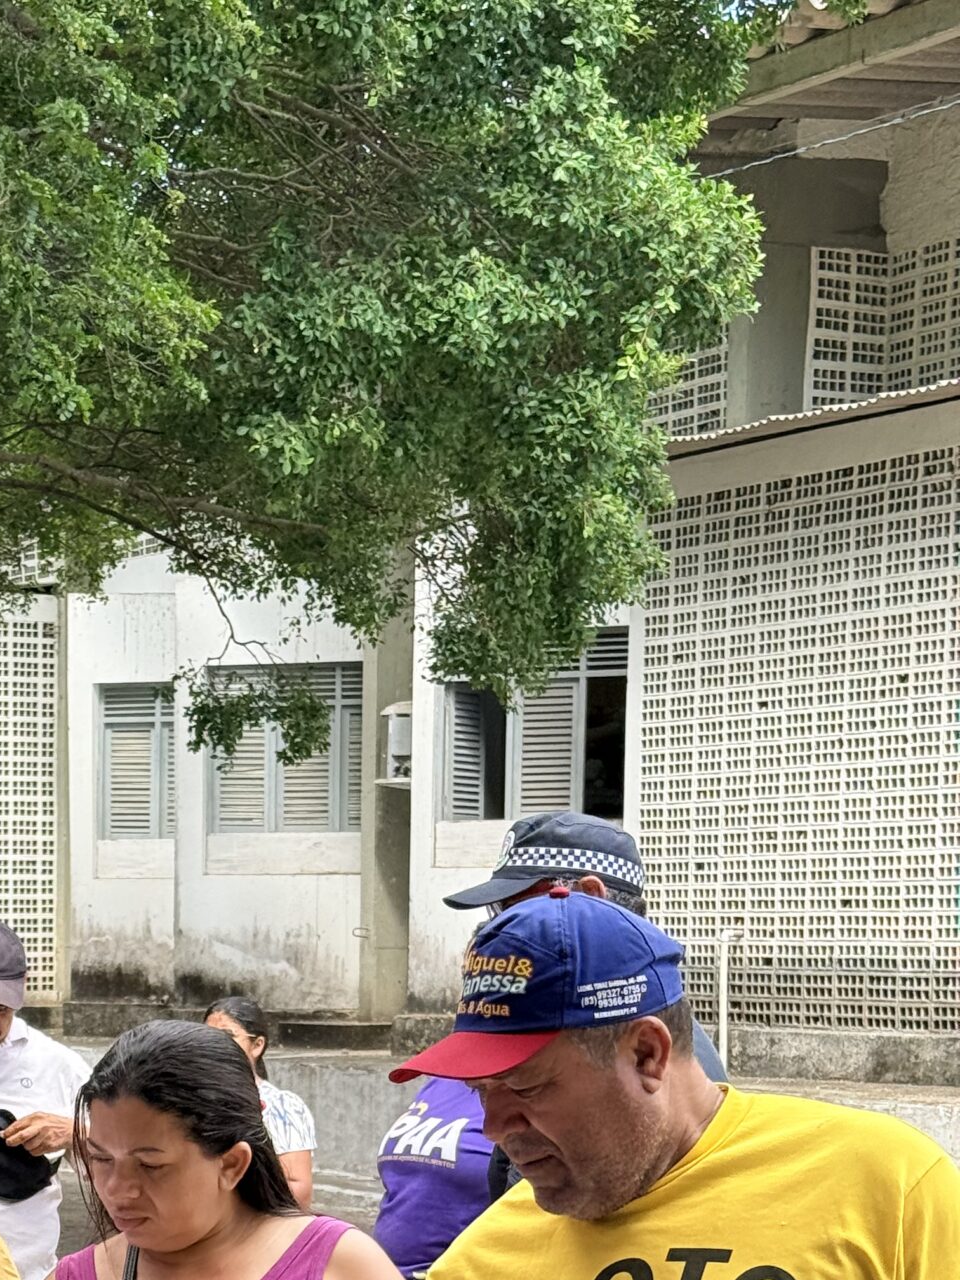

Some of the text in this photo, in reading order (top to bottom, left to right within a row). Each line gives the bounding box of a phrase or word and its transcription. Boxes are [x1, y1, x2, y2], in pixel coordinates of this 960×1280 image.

[464, 974, 527, 996] anessa
[475, 997, 510, 1018] Água
[581, 996, 597, 1008] (83)
[378, 1115, 470, 1162] PAA
